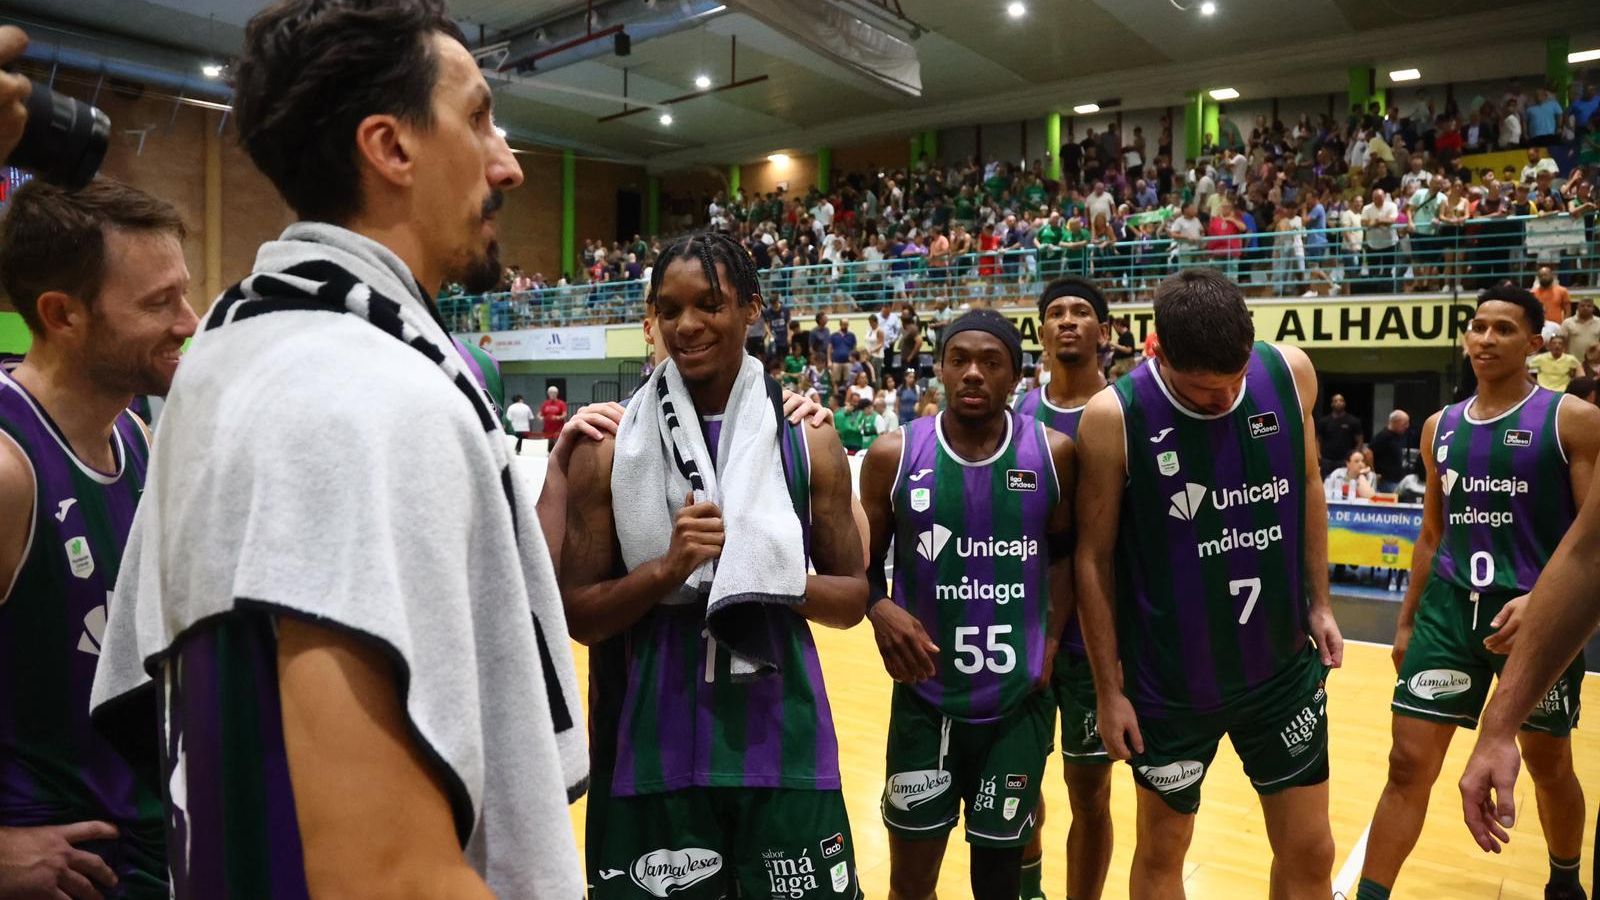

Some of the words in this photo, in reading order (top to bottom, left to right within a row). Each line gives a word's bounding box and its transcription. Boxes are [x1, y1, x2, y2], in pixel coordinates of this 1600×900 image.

[1212, 476, 1289, 510] Unicaja
[1461, 475, 1528, 497] Unicaja
[1336, 511, 1350, 521] DE
[1449, 506, 1513, 527] málaga
[956, 535, 1038, 561] Unicaja
[1197, 524, 1283, 557] málaga
[1470, 551, 1494, 587] 0
[935, 576, 1025, 605] málaga
[1229, 577, 1262, 625] 7
[953, 624, 1017, 674] 55
[825, 843, 841, 855] acb
[768, 869, 820, 899] laga
